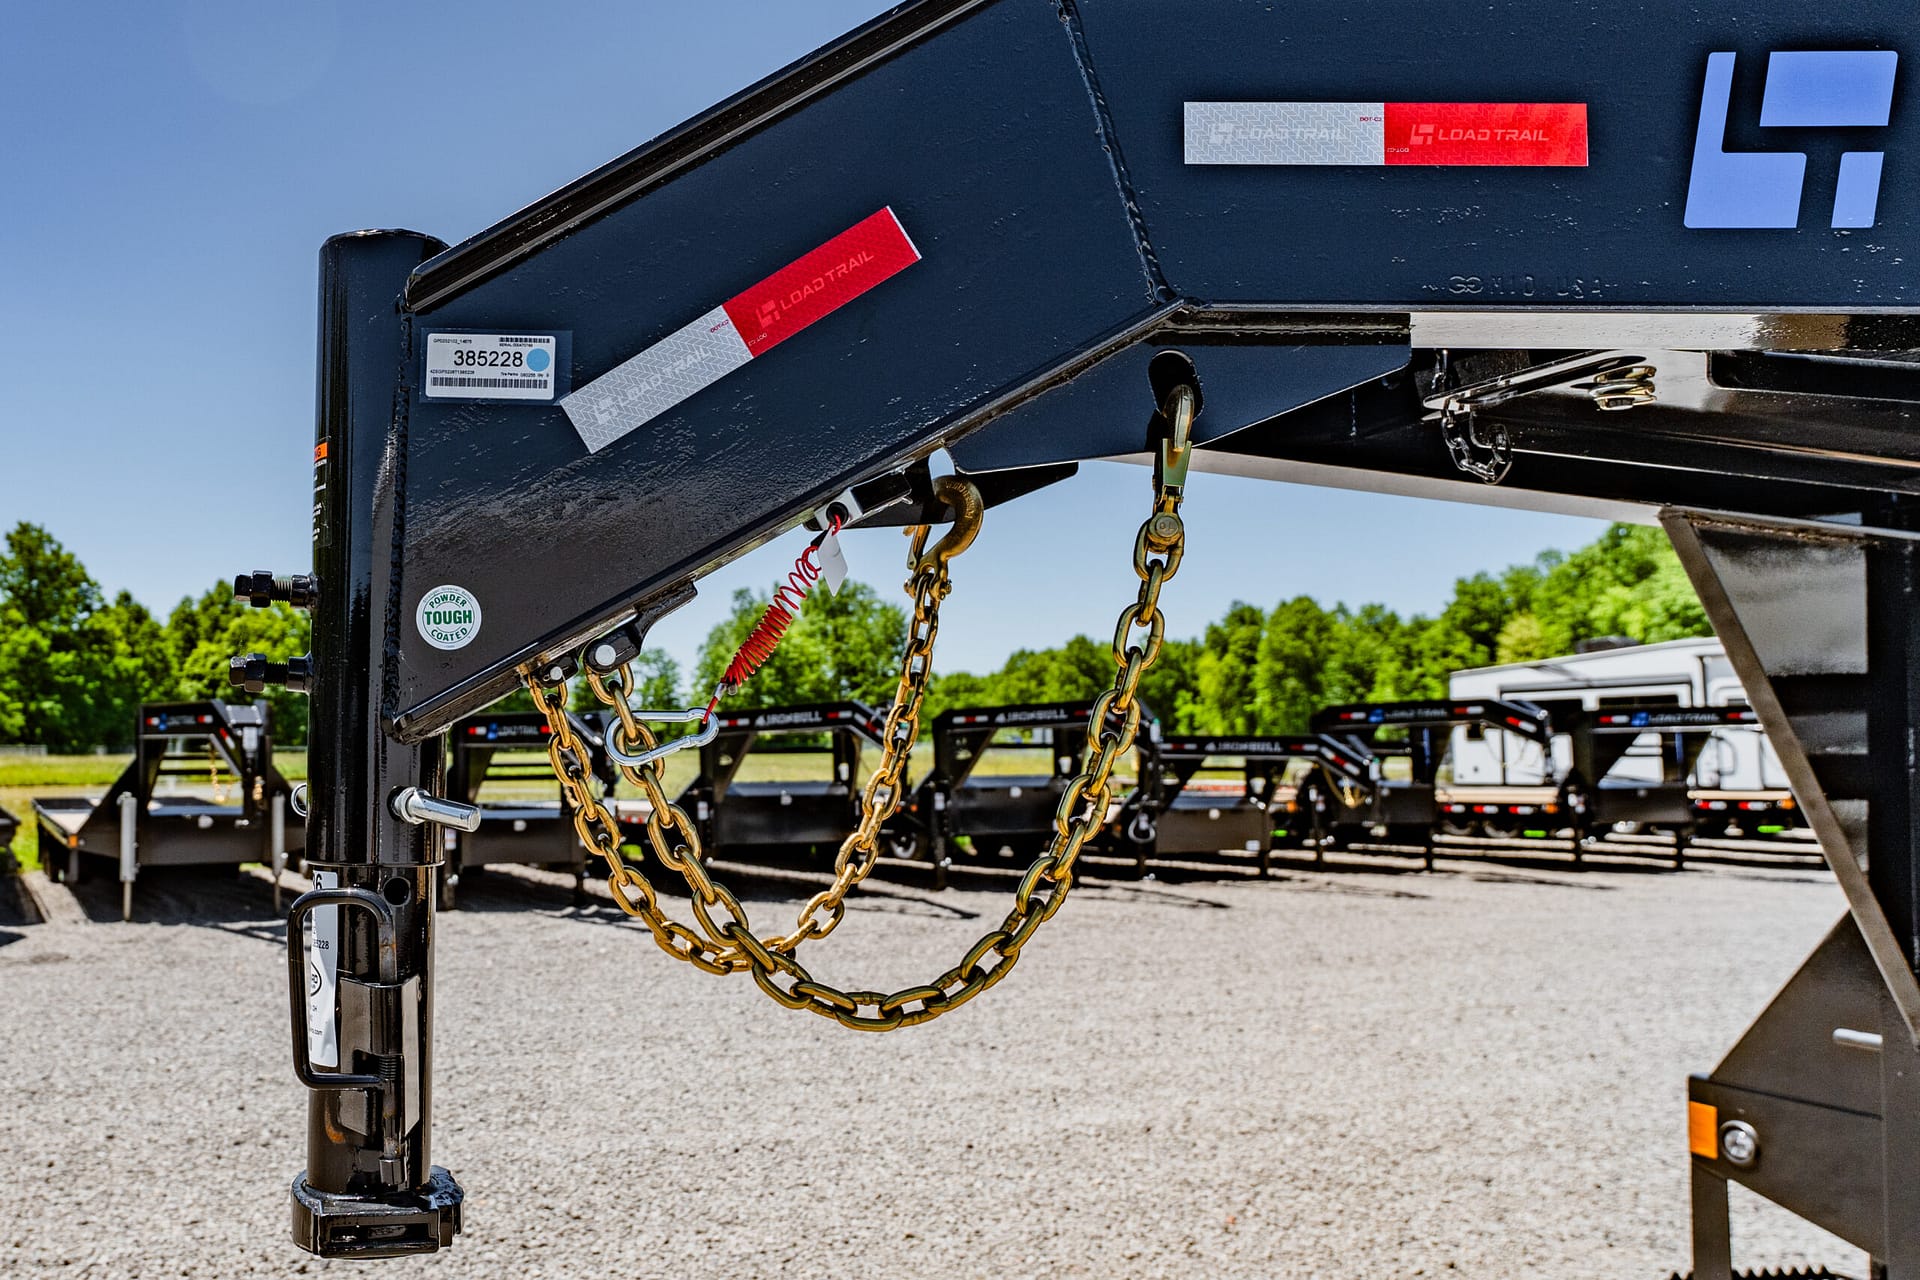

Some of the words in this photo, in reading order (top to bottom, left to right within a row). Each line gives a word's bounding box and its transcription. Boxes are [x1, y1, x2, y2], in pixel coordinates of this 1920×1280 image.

[1438, 128, 1489, 142] LOAD
[1491, 128, 1550, 142] TRAIL
[779, 276, 826, 311] LOAD
[826, 250, 875, 284] TRAIL
[453, 350, 524, 367] 385228
[429, 594, 467, 608] POWDER
[425, 610, 472, 625] TOUGH
[431, 627, 467, 641] COATED
